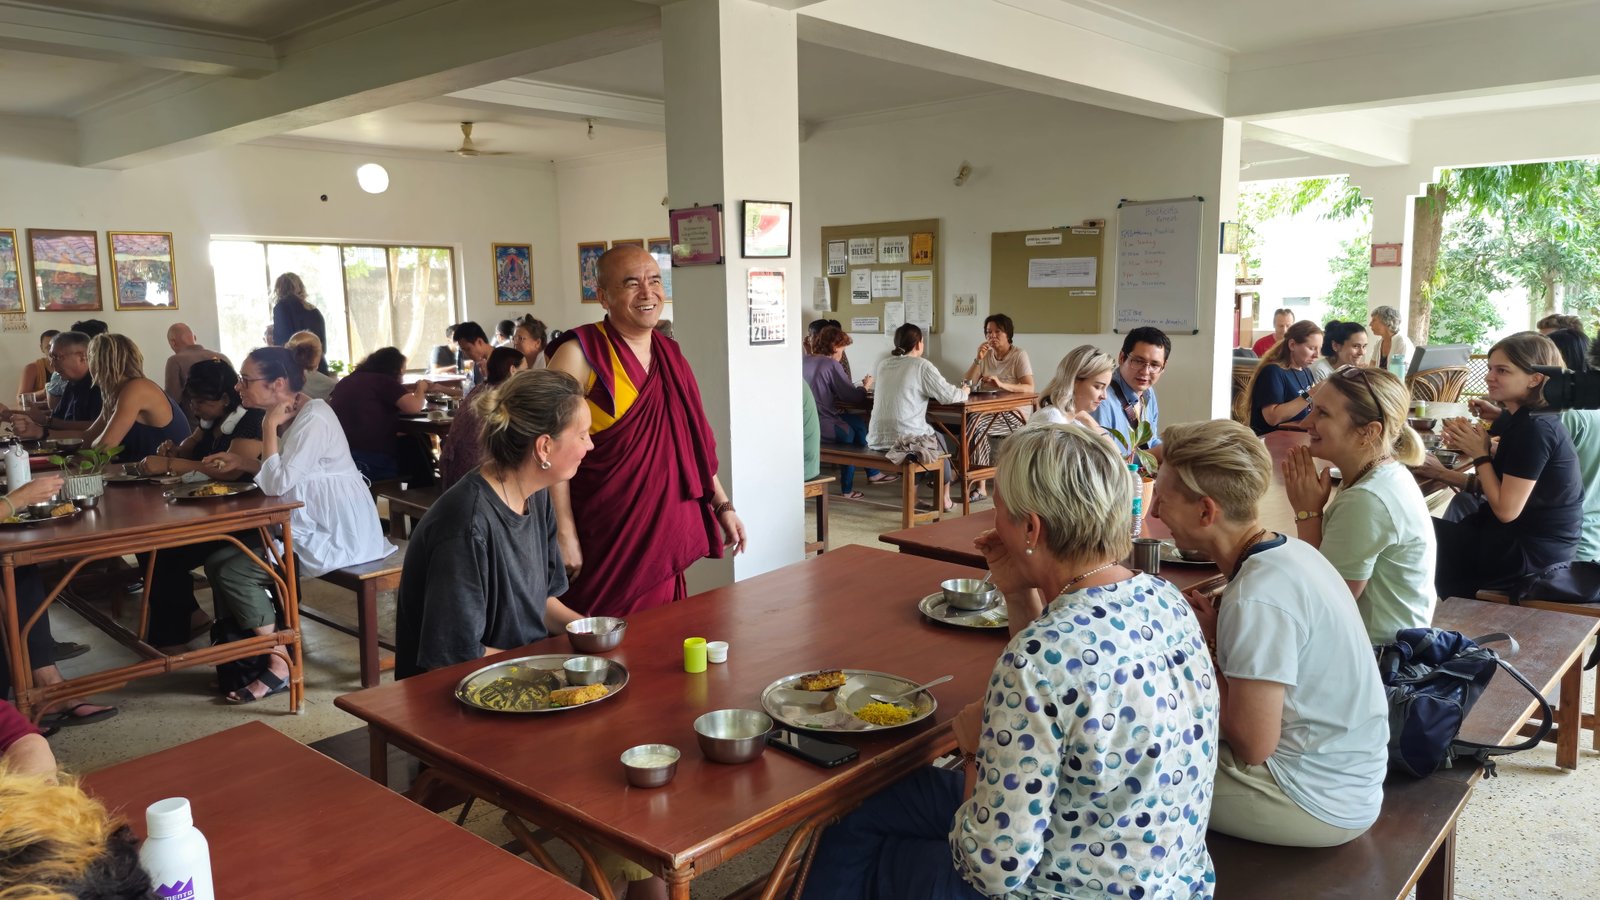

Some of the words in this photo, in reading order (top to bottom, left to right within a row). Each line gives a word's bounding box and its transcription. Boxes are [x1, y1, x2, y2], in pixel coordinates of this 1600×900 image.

[851, 247, 874, 255] SILENCE
[883, 246, 904, 254] SOFTLY
[830, 265, 844, 273] ZONE
